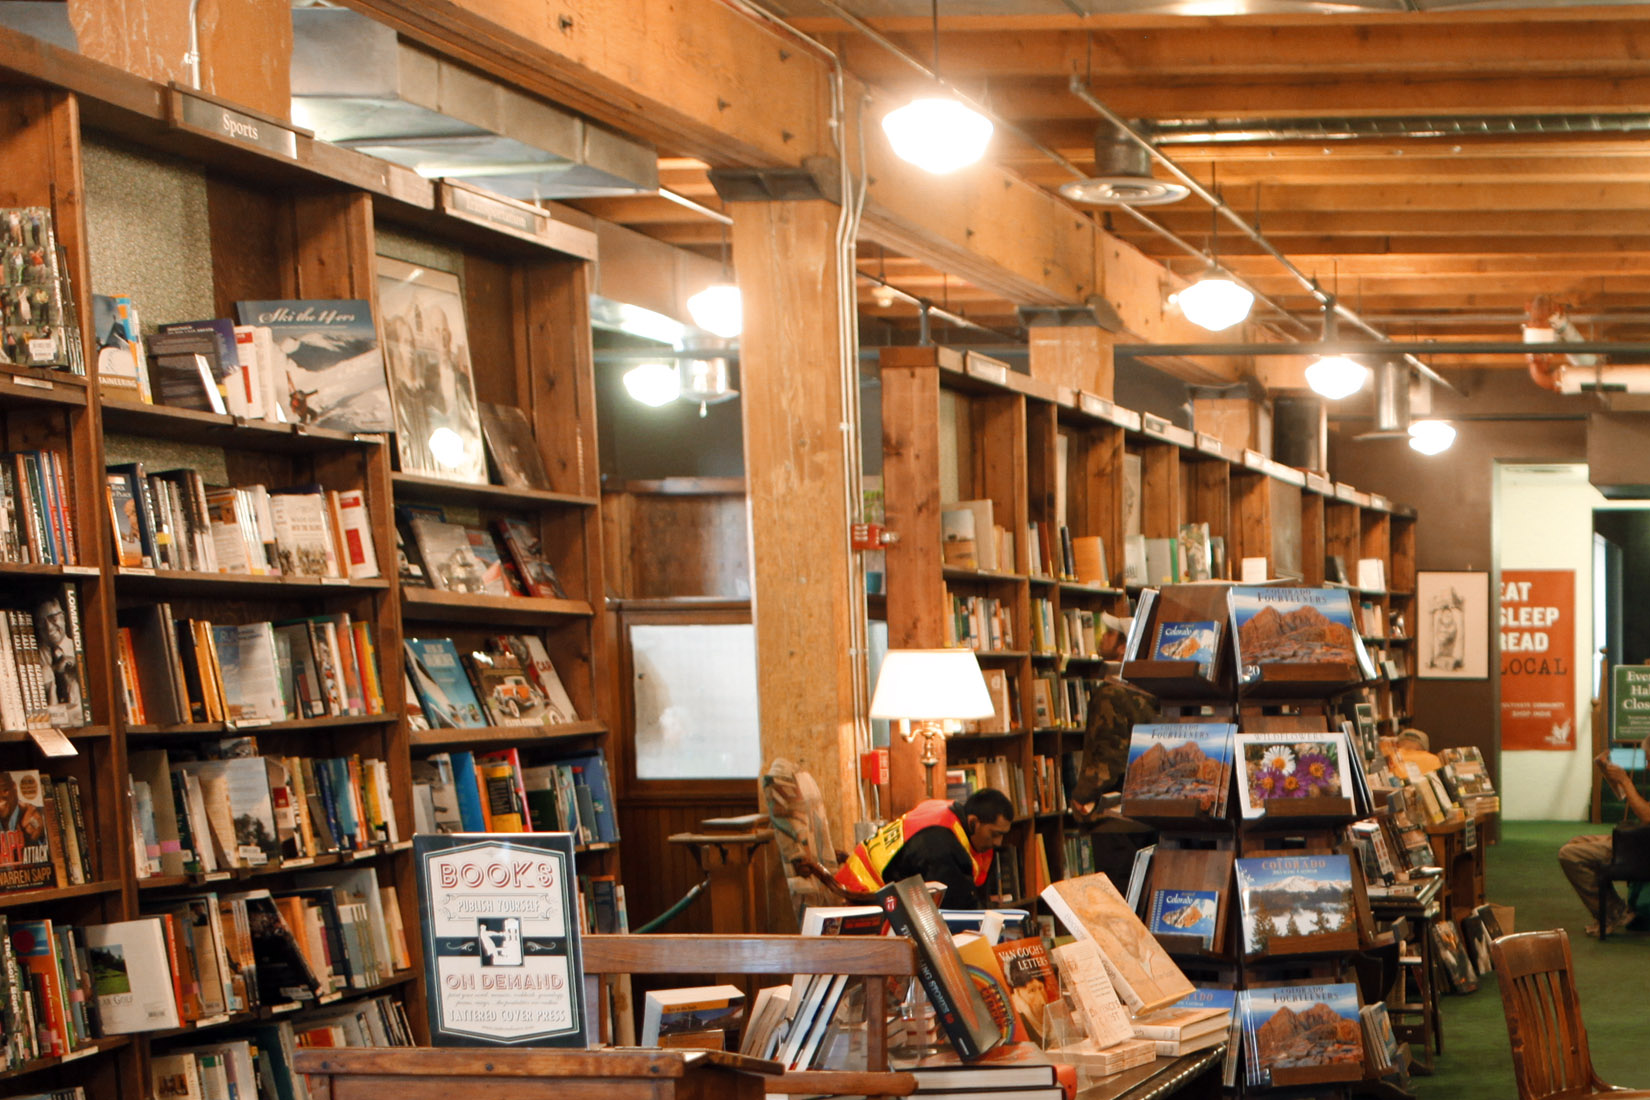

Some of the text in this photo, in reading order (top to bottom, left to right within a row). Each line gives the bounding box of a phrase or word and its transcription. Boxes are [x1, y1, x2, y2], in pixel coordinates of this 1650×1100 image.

[222, 114, 259, 140] Sports
[258, 307, 297, 323] Ski
[296, 307, 316, 322] the
[1257, 592, 1328, 603] FOURTEENERS
[67, 589, 83, 652] LOMBARDI
[1499, 607, 1560, 627] SLEEP
[1165, 625, 1193, 637] Colorado
[1151, 728, 1211, 739] FOURTEENERS
[0, 831, 49, 866] APP ATTACK
[31, 865, 52, 881] SAPP
[1262, 860, 1327, 870] COLORADO
[440, 861, 554, 889] BOOKS
[458, 899, 540, 913] PUBLISH YOURSELF
[1166, 893, 1193, 905] Colorado
[999, 950, 1017, 961] VAN
[1017, 956, 1049, 972] LETTERS
[446, 973, 564, 991] ON DEMAND
[928, 979, 952, 1015] STONES
[1272, 991, 1339, 1003] FOURTEENERS
[450, 1009, 567, 1023] TATTERED COVER PRESS
